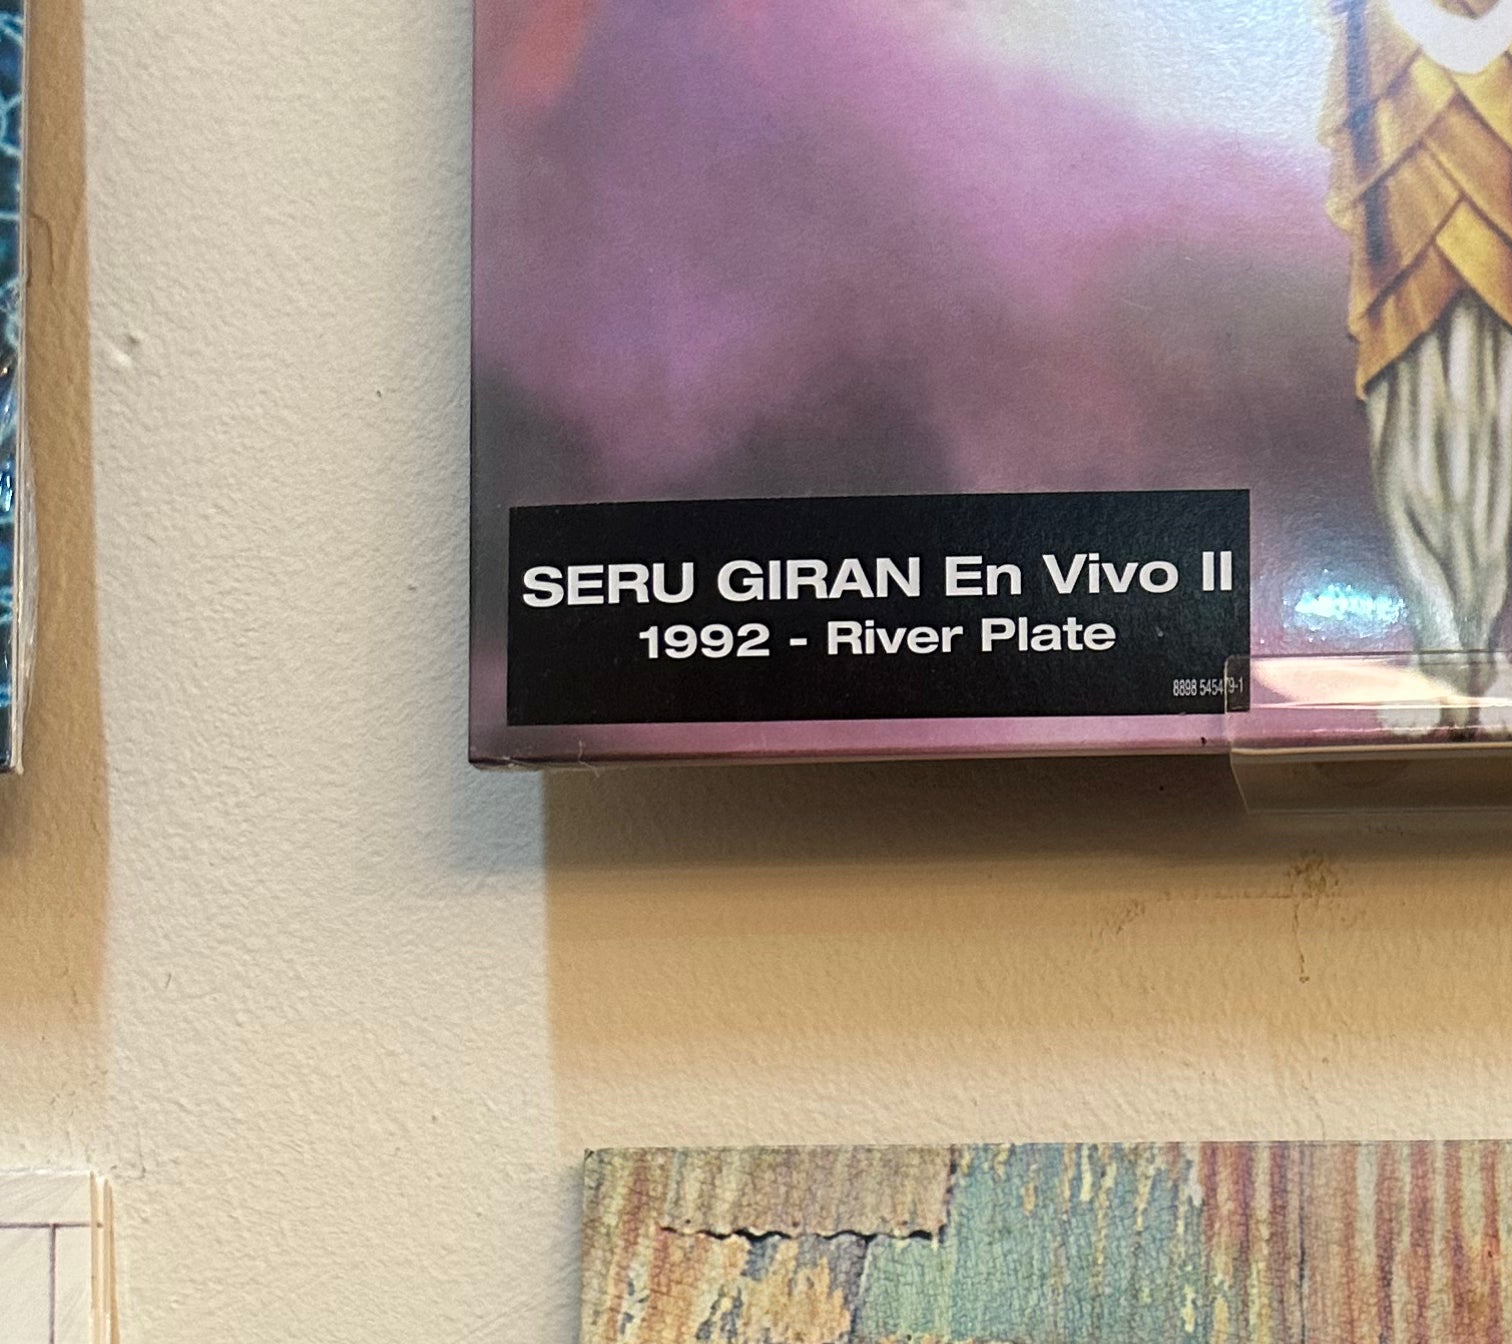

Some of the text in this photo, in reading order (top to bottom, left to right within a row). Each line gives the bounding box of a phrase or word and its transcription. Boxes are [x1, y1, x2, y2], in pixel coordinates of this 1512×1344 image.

[522, 550, 1232, 607] SERU GIRAN En Vivo II
[638, 624, 771, 659] 1992
[828, 620, 963, 655] River
[981, 616, 1116, 653] Plate
[1173, 679, 1197, 696] 8898
